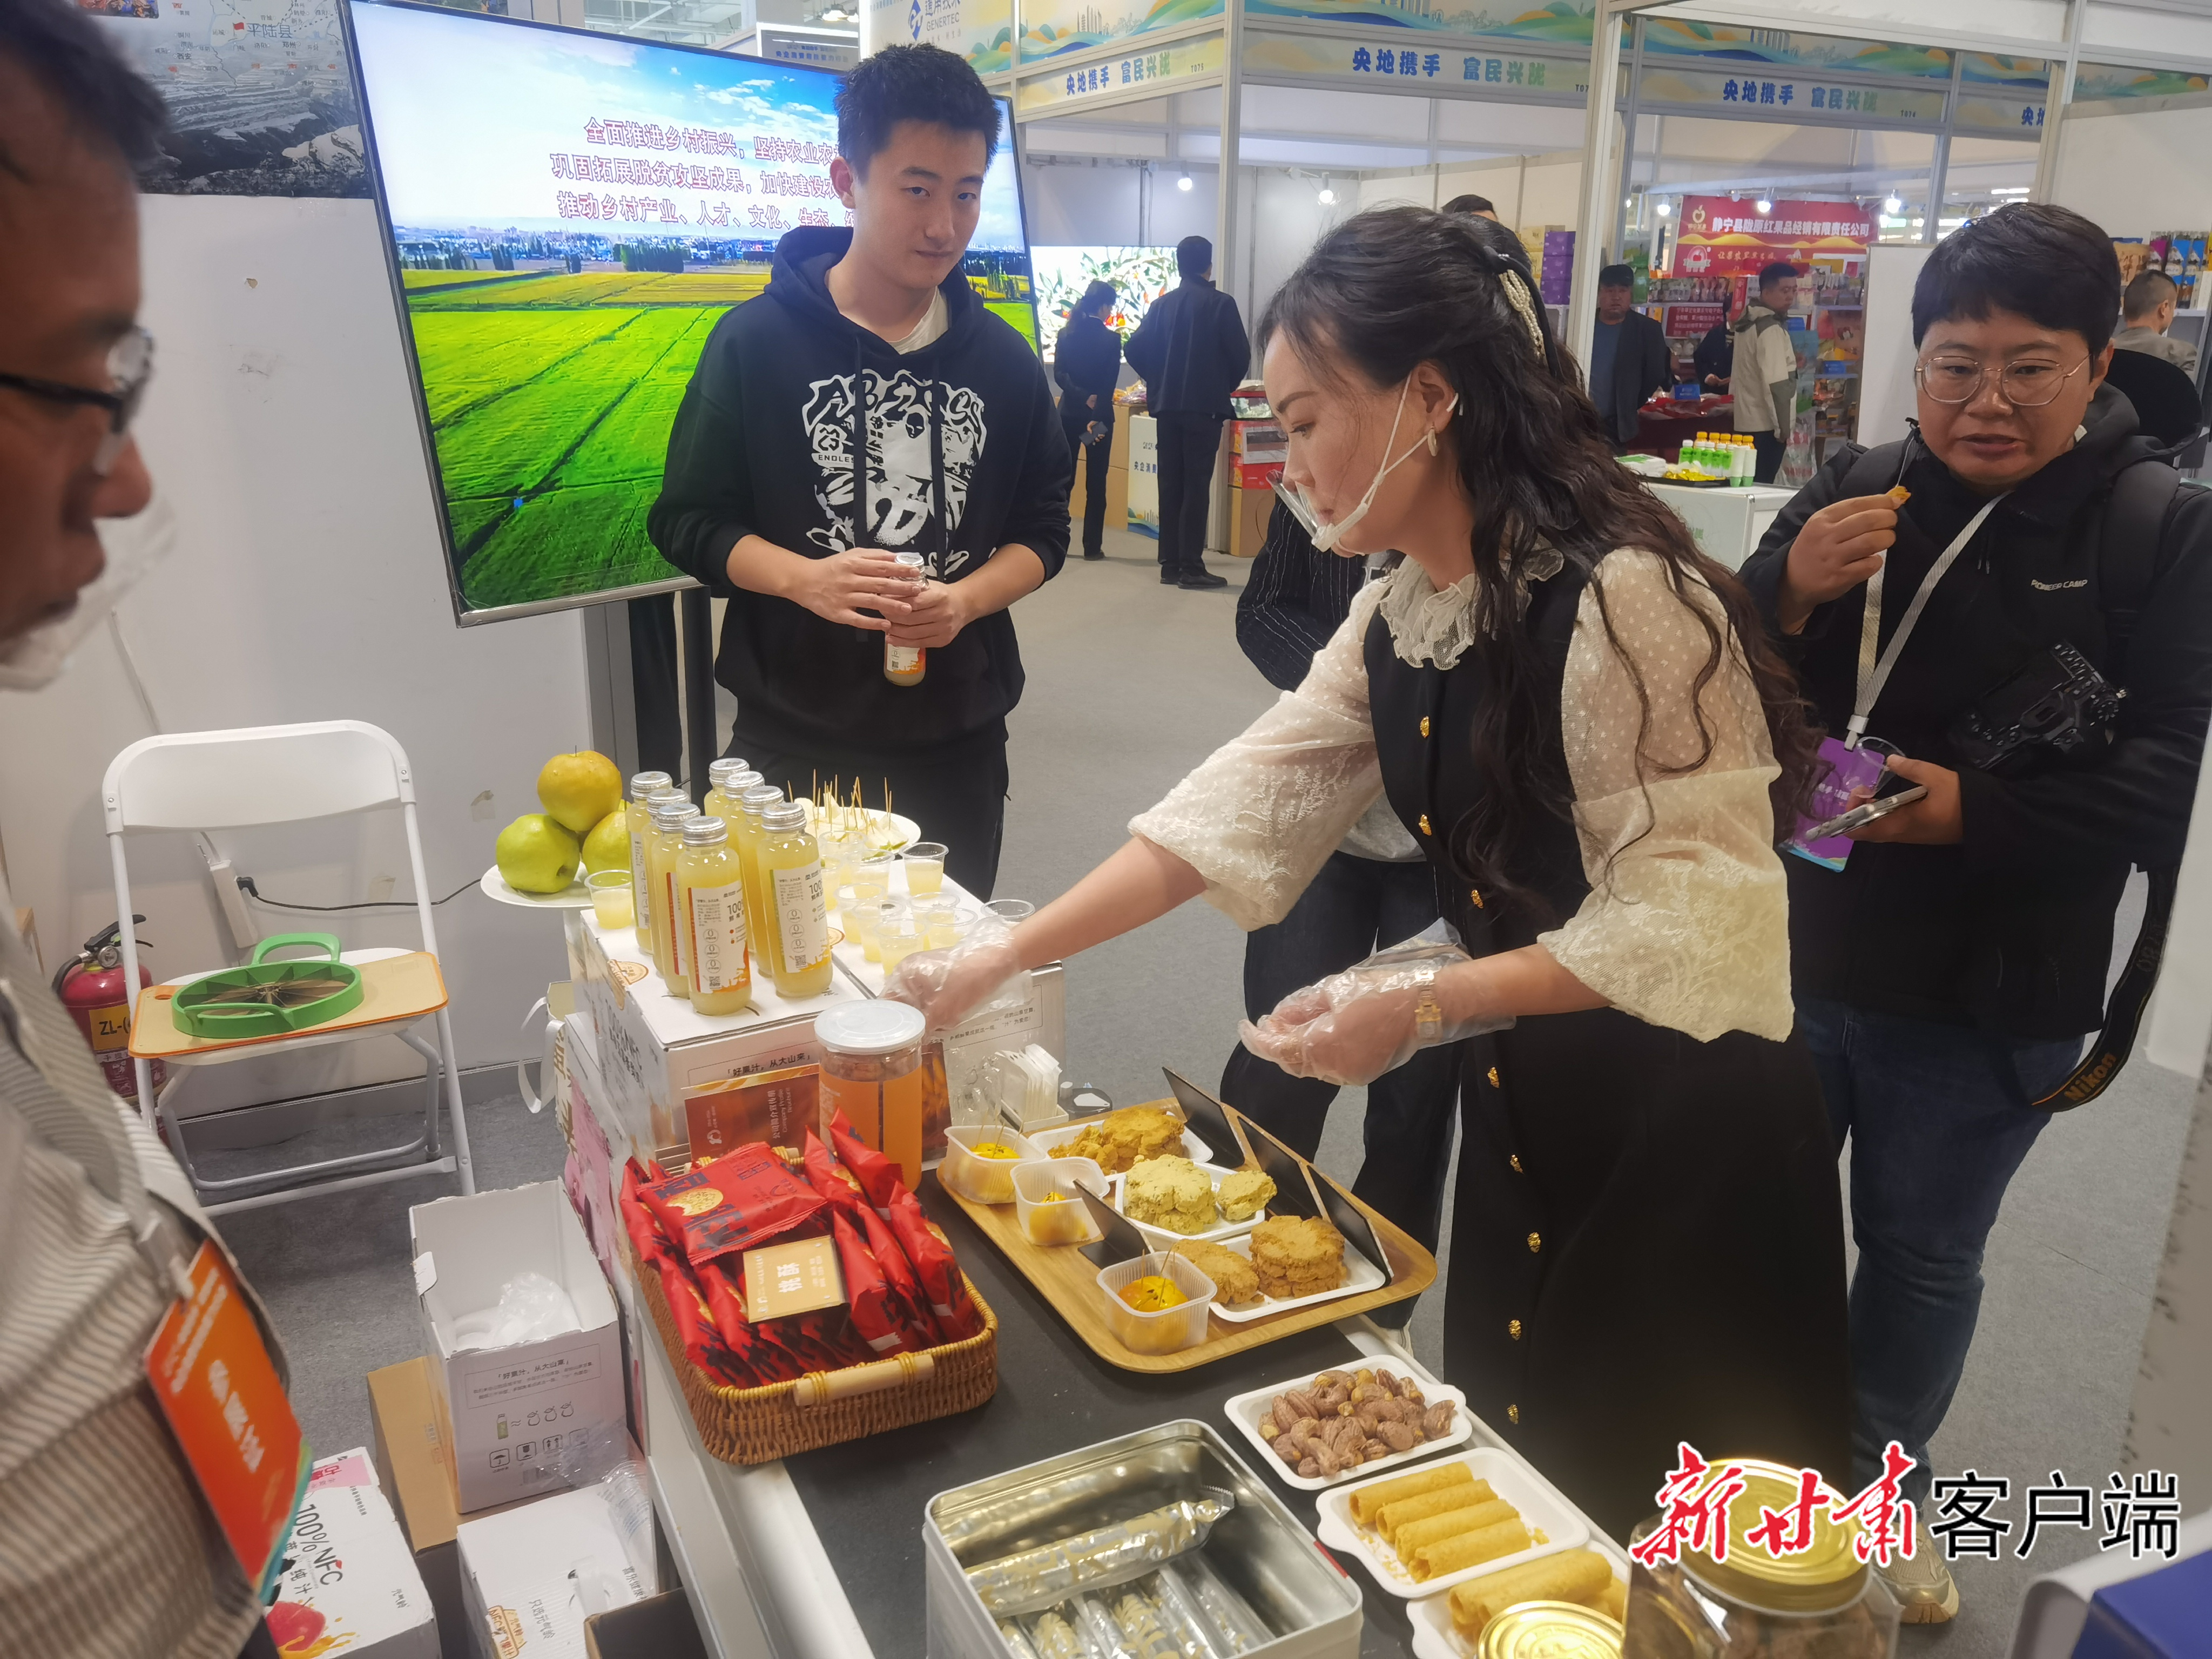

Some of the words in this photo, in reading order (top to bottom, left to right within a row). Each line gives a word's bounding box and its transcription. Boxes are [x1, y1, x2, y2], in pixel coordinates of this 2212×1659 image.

[246, 23, 293, 38] 平陆县
[926, 12, 960, 31] GENERTEC
[1067, 65, 1109, 96] 央地携手
[1121, 52, 1170, 84] 富民兴陇
[1191, 63, 1204, 73] T075
[1352, 47, 1440, 77] 央地携手
[1463, 56, 1546, 86] 富民兴陇
[1723, 79, 1793, 105] 央地携手
[1811, 86, 1878, 112] 富民兴陇
[584, 116, 839, 166] 全面推进乡村振兴，坚持农业农
[2062, 579, 2088, 589] CAMP
[2063, 1053, 2116, 1101] Nikon
[313, 1547, 343, 1586] NFC
